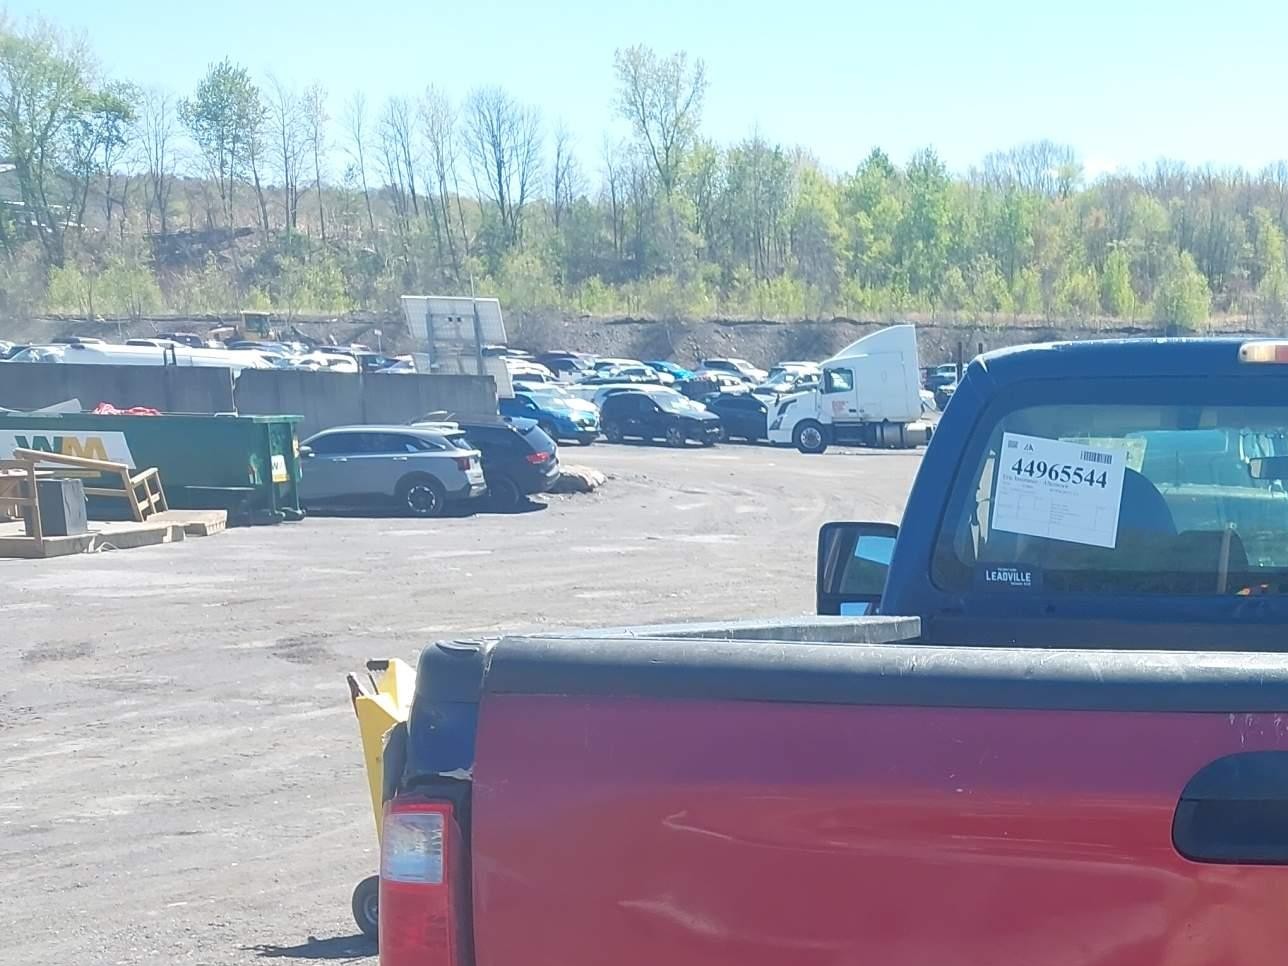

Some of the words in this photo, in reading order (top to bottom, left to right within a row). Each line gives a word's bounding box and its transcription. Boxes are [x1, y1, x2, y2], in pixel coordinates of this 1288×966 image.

[15, 435, 111, 461] WM
[1011, 457, 1108, 489] 44965544
[985, 569, 1032, 582] LEADVILLE
